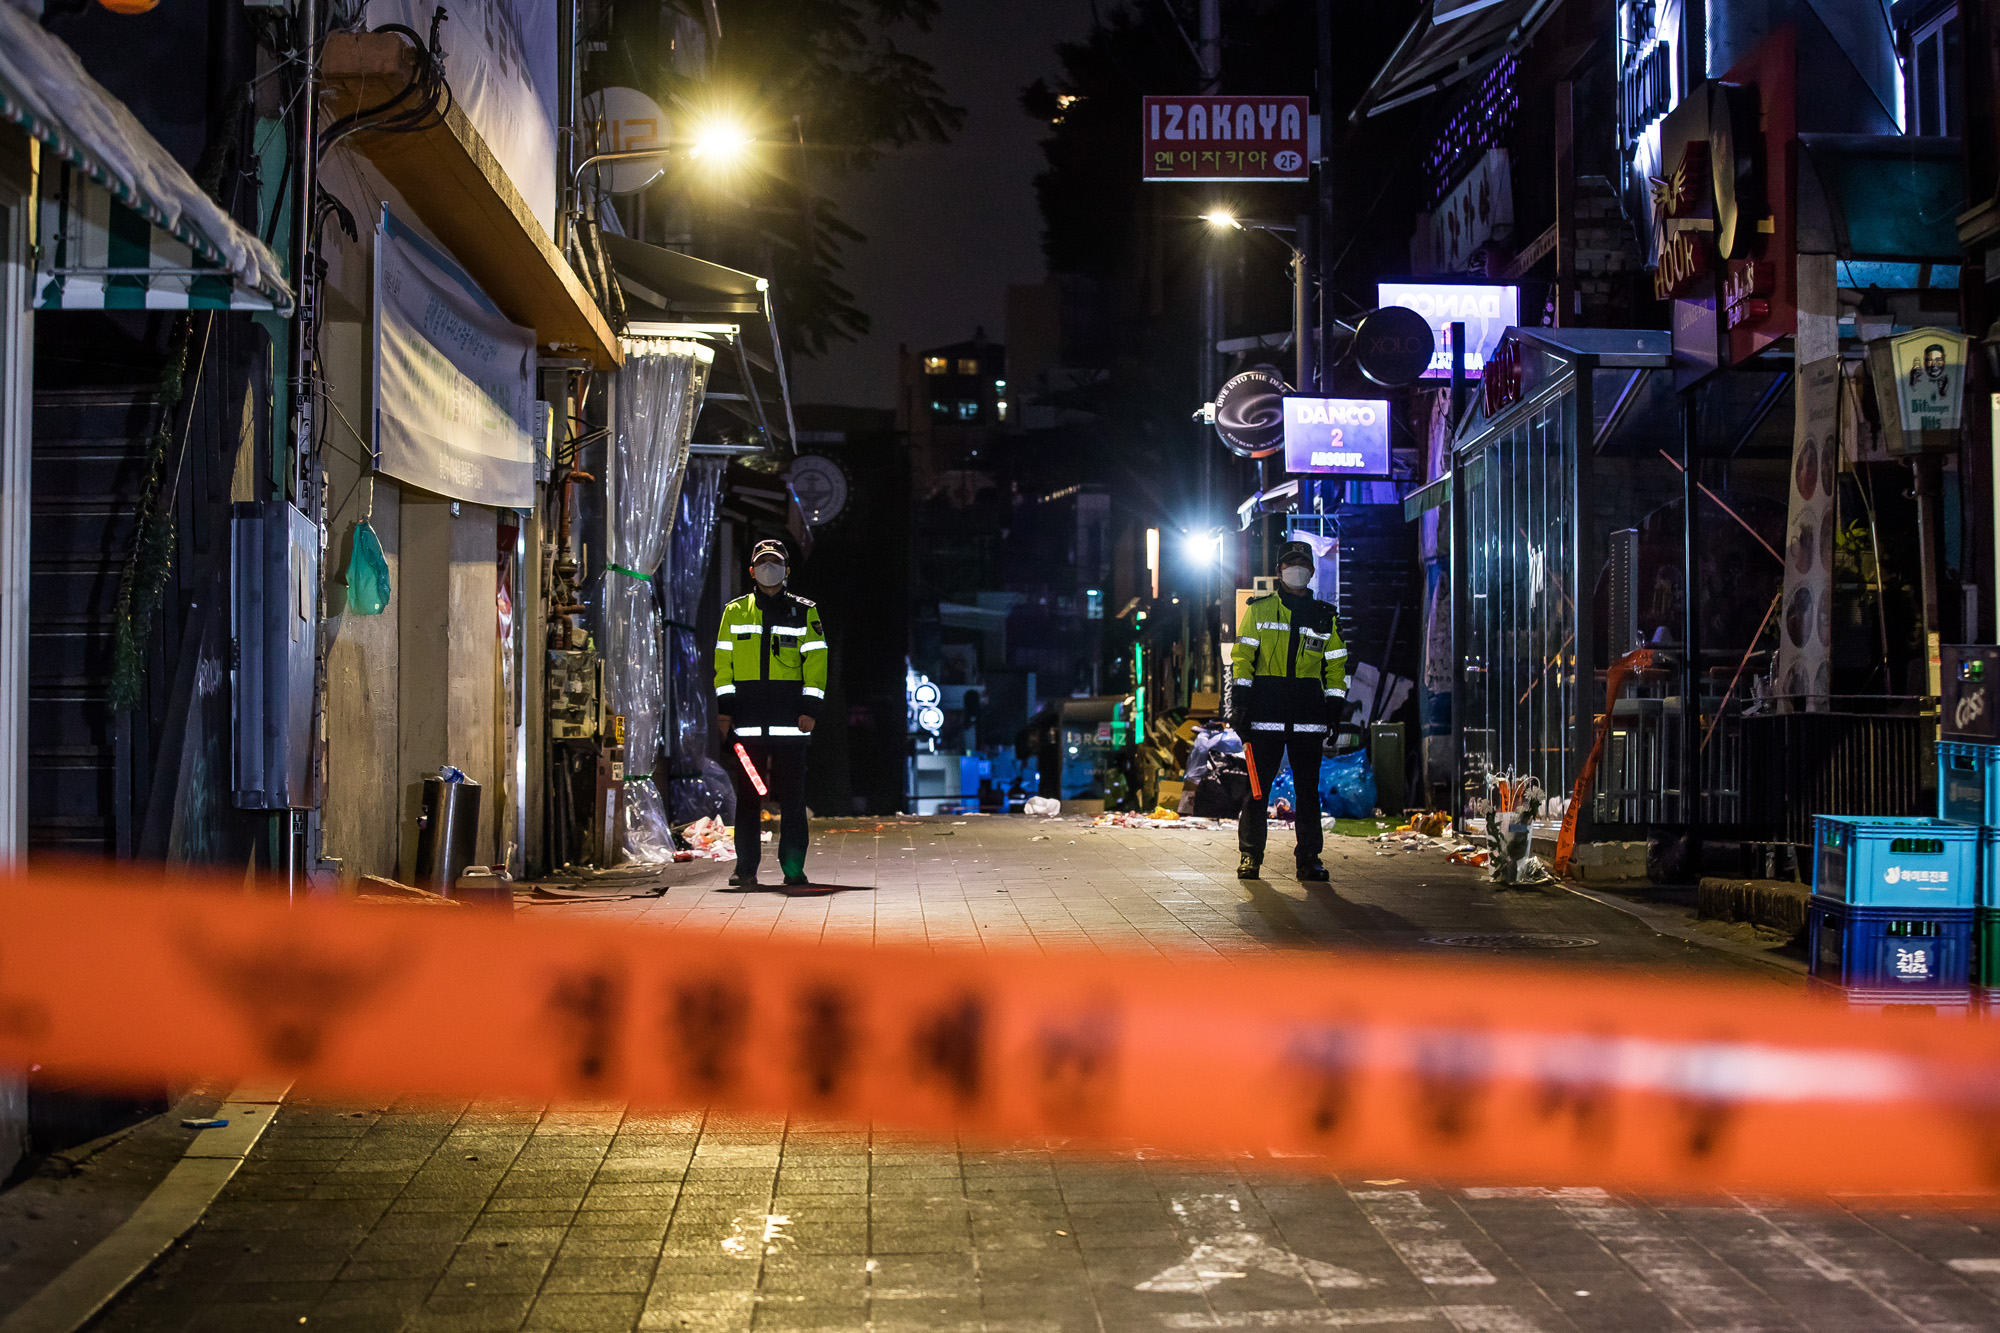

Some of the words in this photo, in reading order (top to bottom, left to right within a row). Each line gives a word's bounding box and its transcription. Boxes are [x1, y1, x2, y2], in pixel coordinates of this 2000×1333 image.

[1151, 104, 1300, 140] IZAKAYA
[1280, 155, 1297, 169] 2F
[1654, 230, 1696, 301] HOOK
[1371, 337, 1421, 353] XOLO
[1216, 388, 1230, 408] DIVE
[1227, 375, 1248, 390] INTO
[1249, 373, 1268, 382] THE
[1297, 405, 1376, 427] DANCO
[1330, 428, 1344, 447] 2
